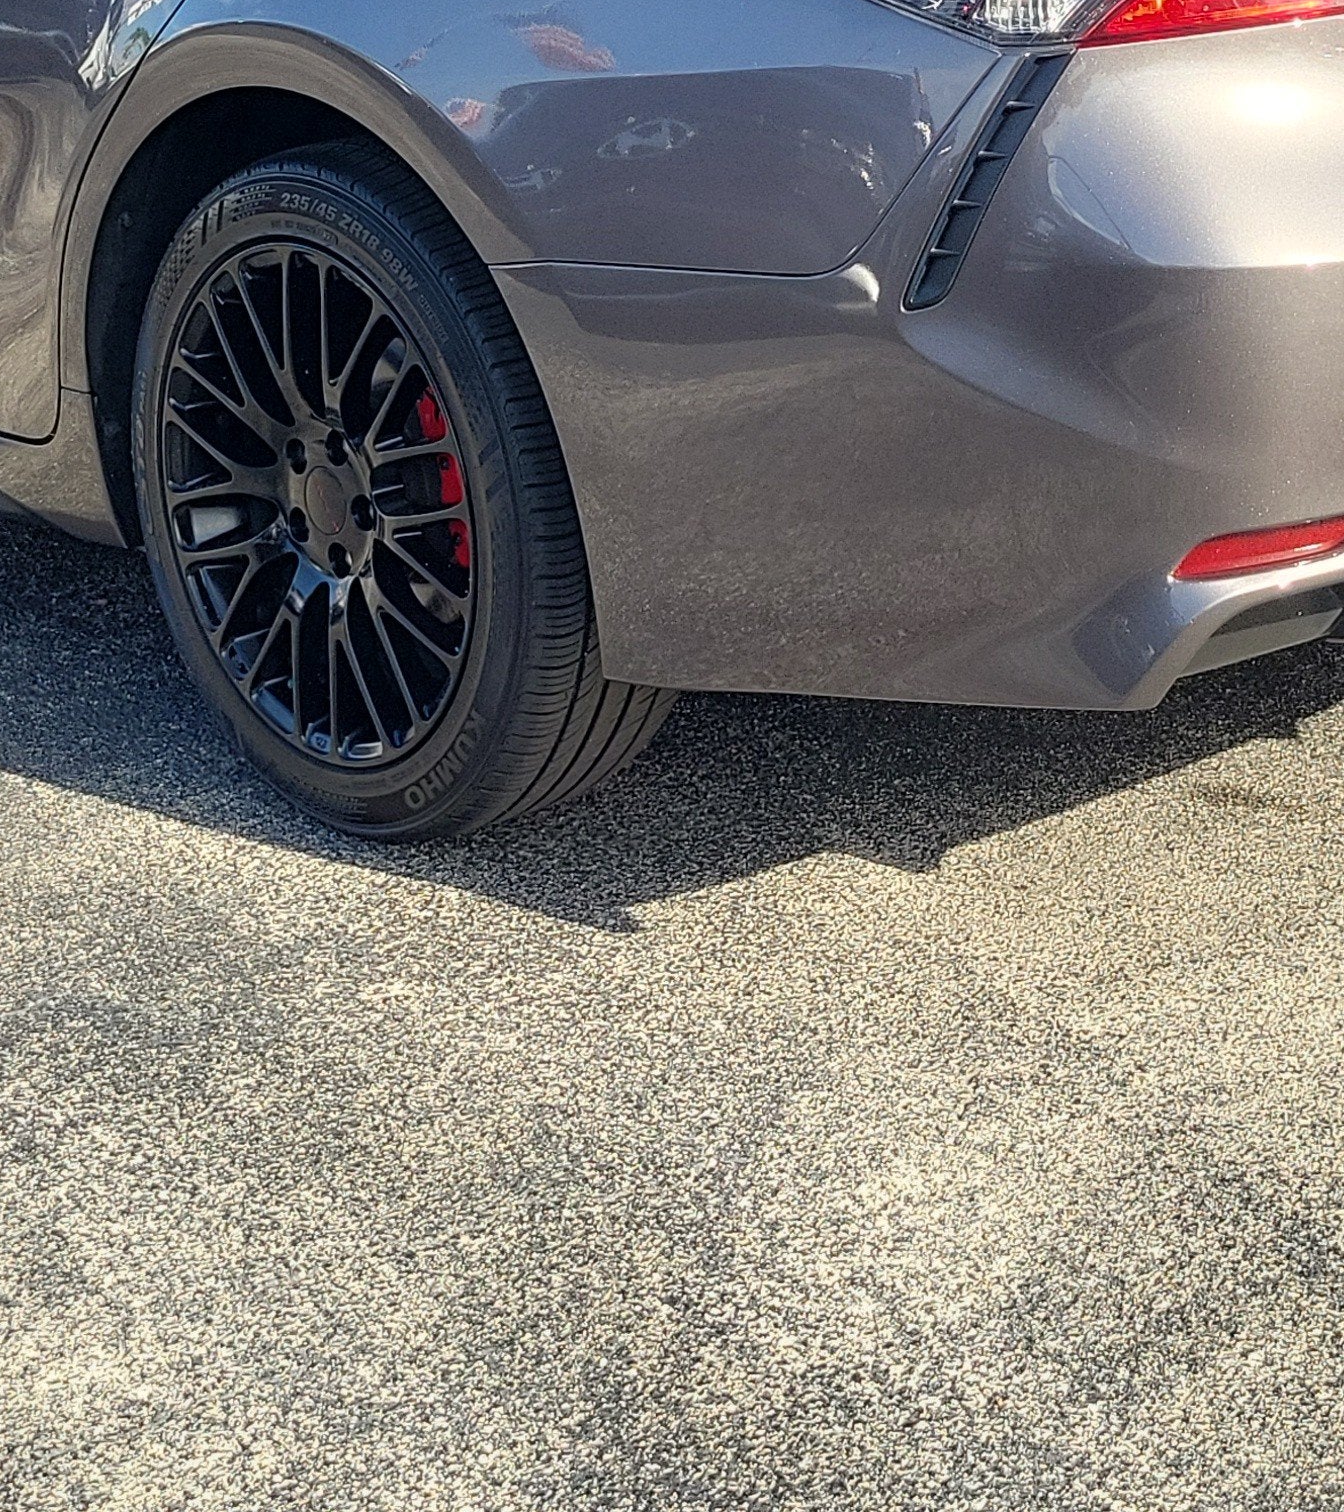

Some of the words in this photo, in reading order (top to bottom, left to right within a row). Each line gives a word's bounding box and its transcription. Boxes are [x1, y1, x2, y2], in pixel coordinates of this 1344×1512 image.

[280, 192, 338, 222] 235/45
[338, 213, 380, 253] ZR18
[380, 248, 419, 292] 98W
